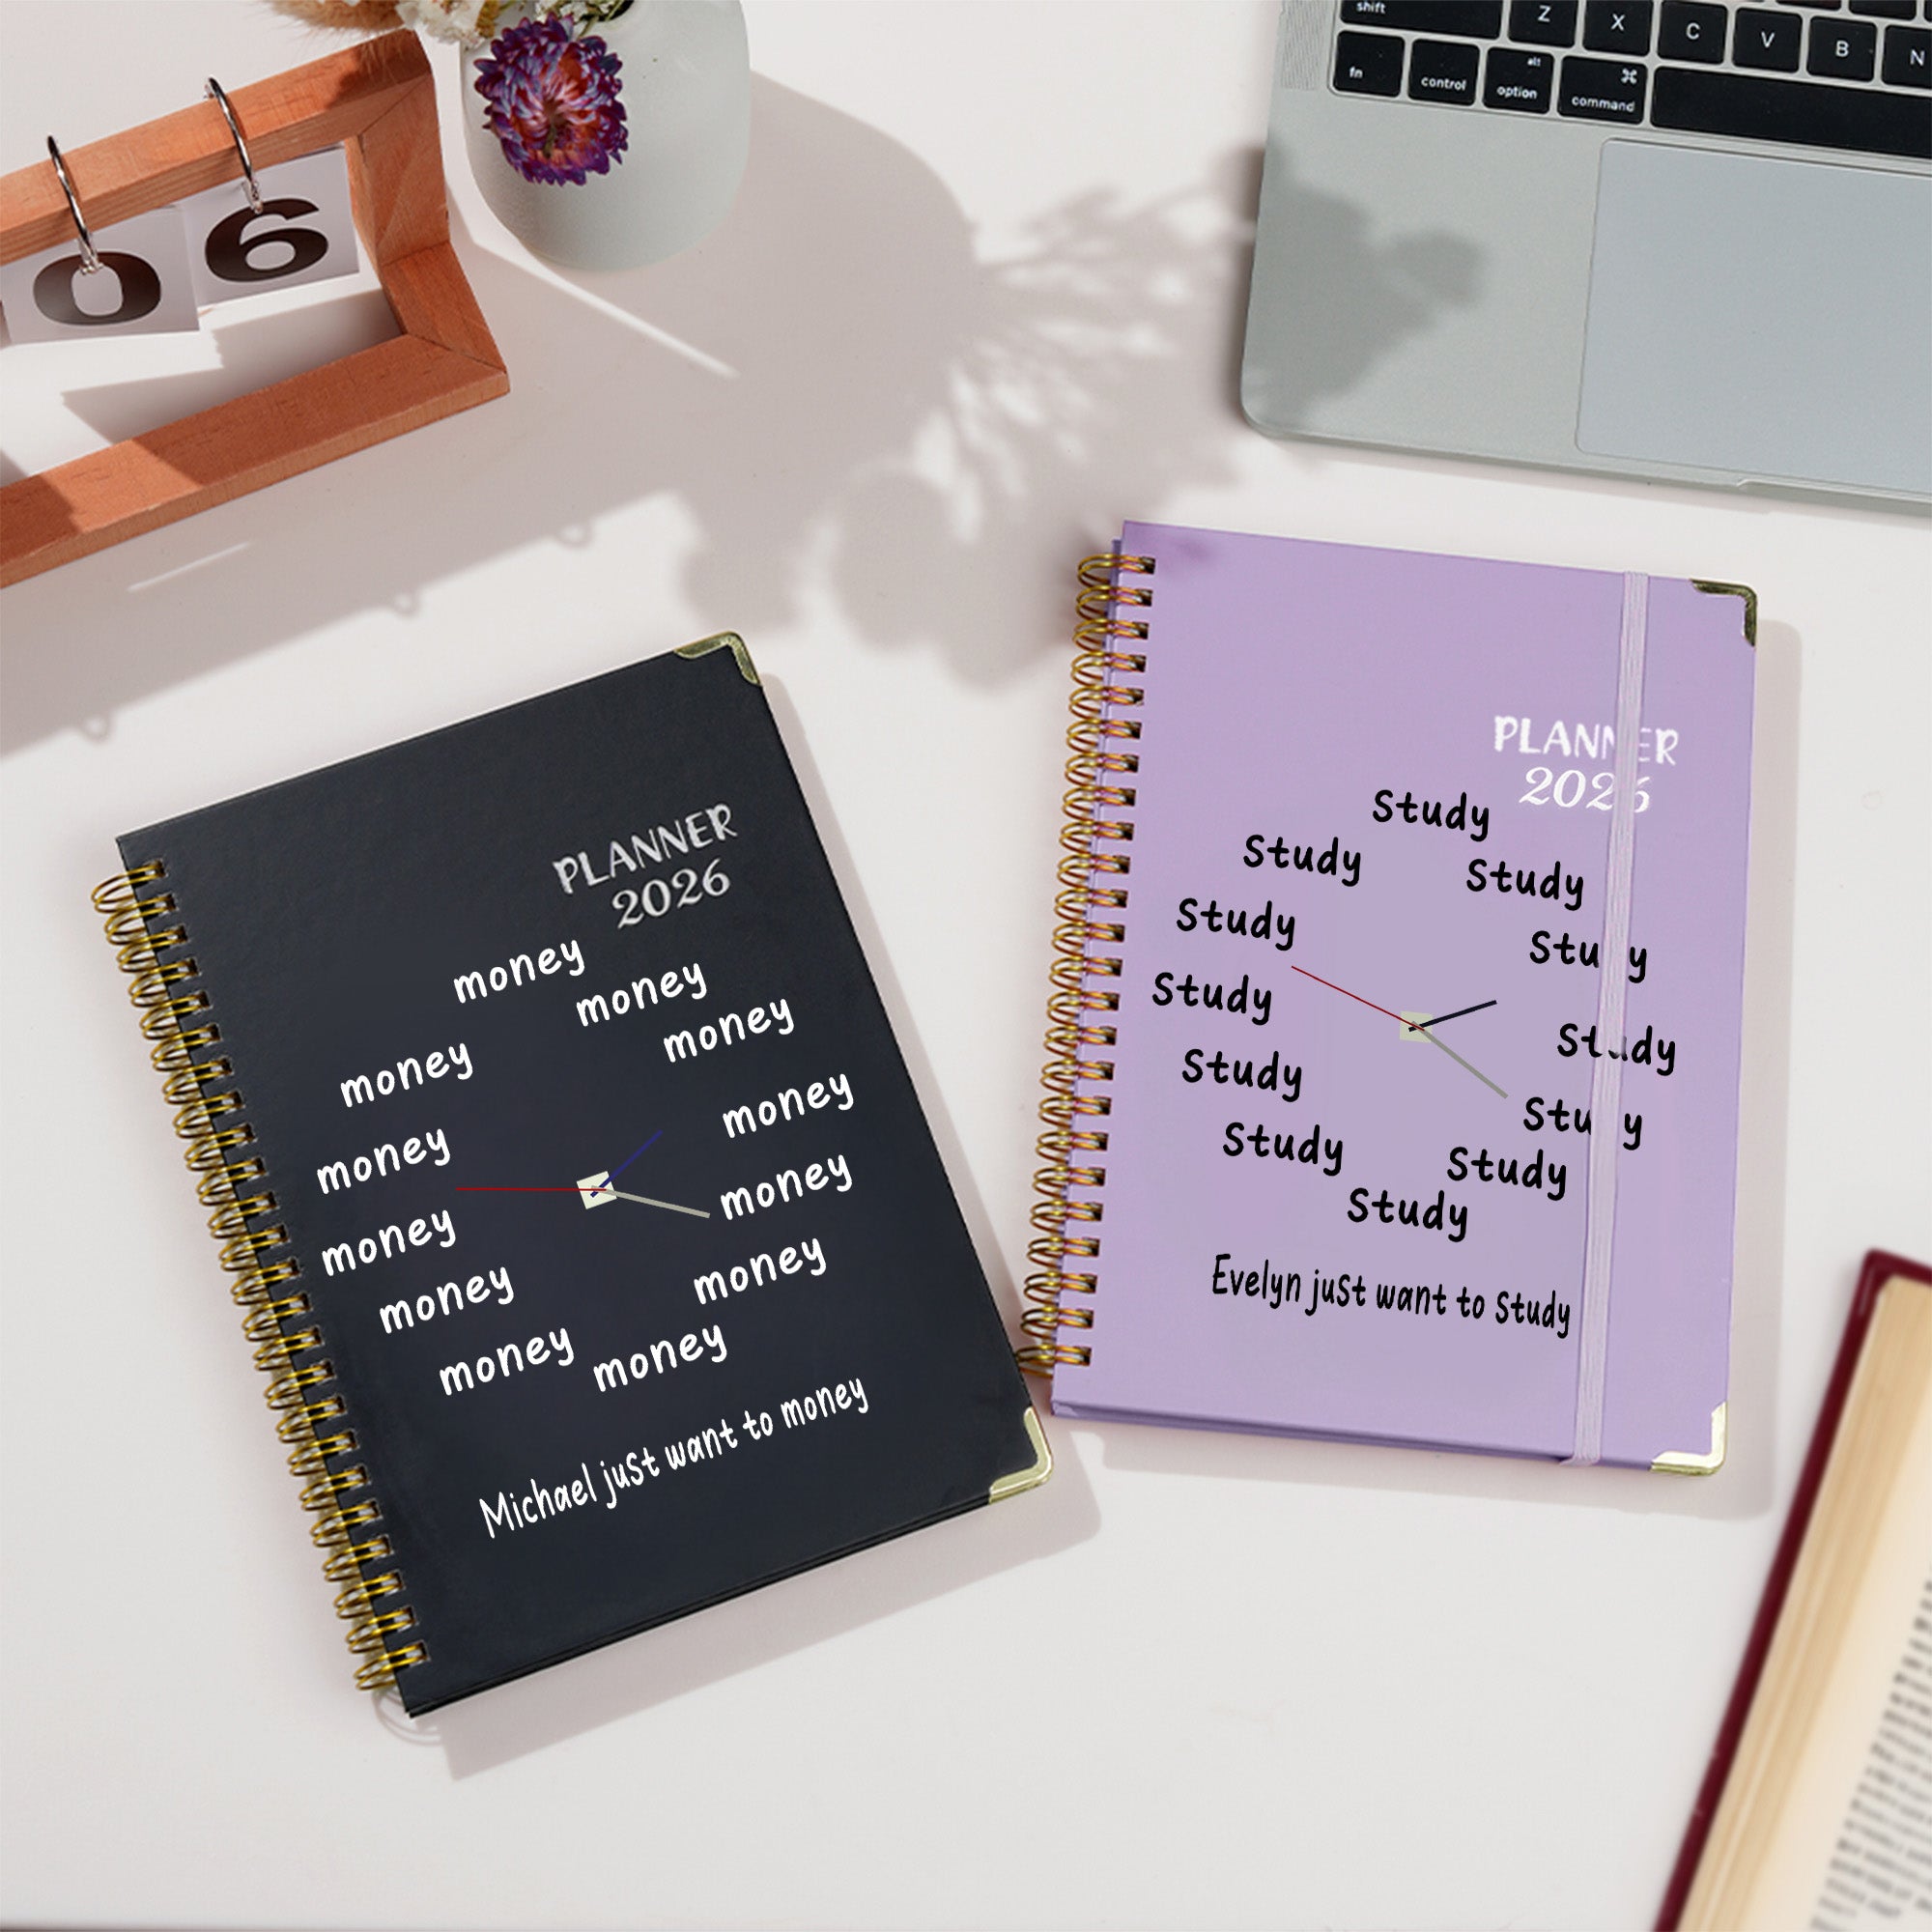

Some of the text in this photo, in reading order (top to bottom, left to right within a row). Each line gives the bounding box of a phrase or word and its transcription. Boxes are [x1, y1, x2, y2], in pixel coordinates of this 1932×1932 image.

[1538, 6, 1551, 22] Z
[1611, 14, 1625, 30] X
[1686, 22, 1701, 40] C
[1761, 32, 1775, 48] V
[1350, 67, 1363, 78] fn
[1835, 41, 1850, 57] B
[1910, 49, 1925, 66] N
[1421, 77, 1466, 91] control
[1496, 86, 1538, 99] option
[1572, 96, 1635, 112] command
[205, 198, 329, 282] 6
[1373, 790, 1490, 841] Study
[553, 804, 738, 894] PLANNER
[1243, 835, 1361, 887] Study
[611, 858, 731, 929] 2026
[1466, 859, 1583, 911] Study
[1177, 897, 1295, 951] Study
[453, 940, 584, 1003] money
[1530, 930, 1647, 983] Stuy
[577, 963, 707, 1027] money
[1152, 972, 1272, 1025] Study
[664, 999, 794, 1063] money
[341, 1043, 473, 1108] money
[1182, 1048, 1302, 1102] Study
[723, 1074, 854, 1138] money
[1523, 1097, 1642, 1151] Stuy
[317, 1129, 451, 1194] money
[1223, 1122, 1343, 1176] Study
[1447, 1147, 1567, 1201] Study
[721, 1155, 853, 1220] money
[1348, 1188, 1468, 1242] Study
[322, 1210, 457, 1276] money
[694, 1238, 827, 1304] money
[1212, 1254, 1301, 1308] Evelyn
[1305, 1269, 1366, 1316] just
[1377, 1284, 1447, 1316] want
[1457, 1287, 1486, 1319] to
[380, 1267, 515, 1333] money
[440, 1327, 575, 1396] money
[593, 1324, 727, 1392] money
[478, 1378, 869, 1539] Michael just want to money
